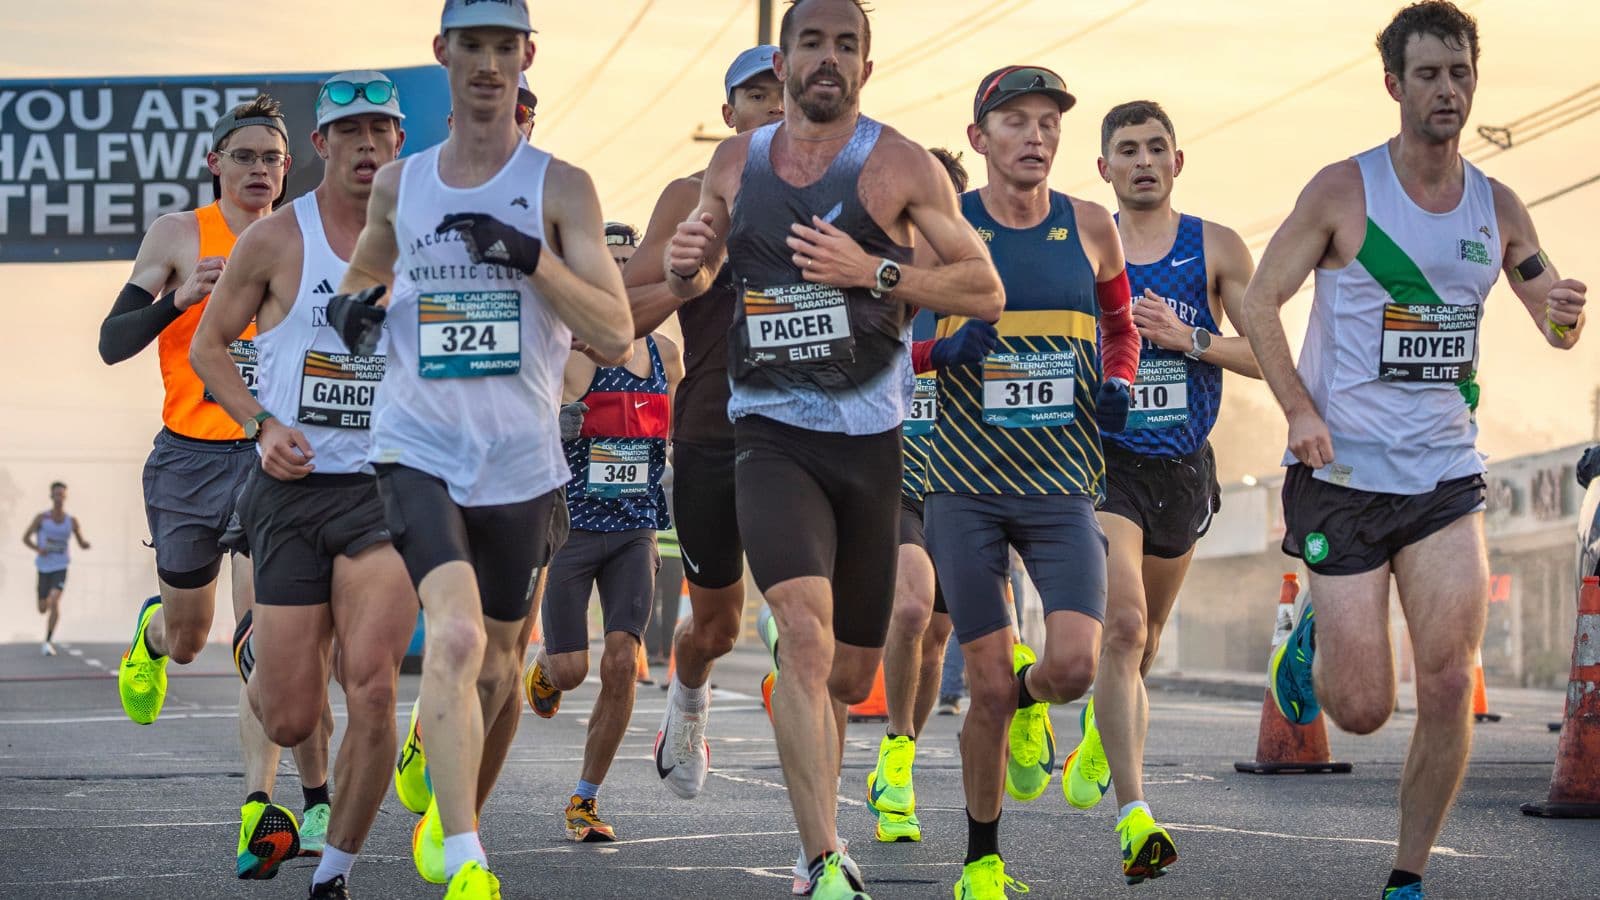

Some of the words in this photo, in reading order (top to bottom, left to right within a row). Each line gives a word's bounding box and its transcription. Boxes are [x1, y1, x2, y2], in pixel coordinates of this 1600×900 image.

[463, 292, 518, 302] CALIFORNIA
[775, 289, 843, 304] INTERNATIONAL
[446, 302, 518, 311] INTERNATIONAL
[794, 296, 845, 310] MARATHON
[1408, 305, 1430, 314] 2024
[465, 310, 519, 320] MARATHON
[759, 314, 833, 341] PACER
[1438, 321, 1476, 330] MARATHON
[441, 324, 497, 352] 324
[1398, 336, 1465, 358] ROYER
[788, 344, 832, 361] ELITE
[998, 354, 1020, 362] 2024
[1026, 352, 1074, 362] CALIFORNIA
[329, 355, 349, 363] 2024
[470, 360, 520, 370] MARATHON
[1010, 361, 1074, 370] INTERNATIONAL
[1028, 368, 1074, 377] MARATHON
[1422, 366, 1460, 379] ELITE
[1143, 374, 1186, 382] MARATHON
[312, 382, 375, 407] GARCI
[1005, 381, 1054, 406] 316
[340, 414, 370, 427] ELIT
[1031, 412, 1074, 421] MARATHON
[1147, 414, 1188, 423] MARATHON
[604, 464, 637, 482] 349
